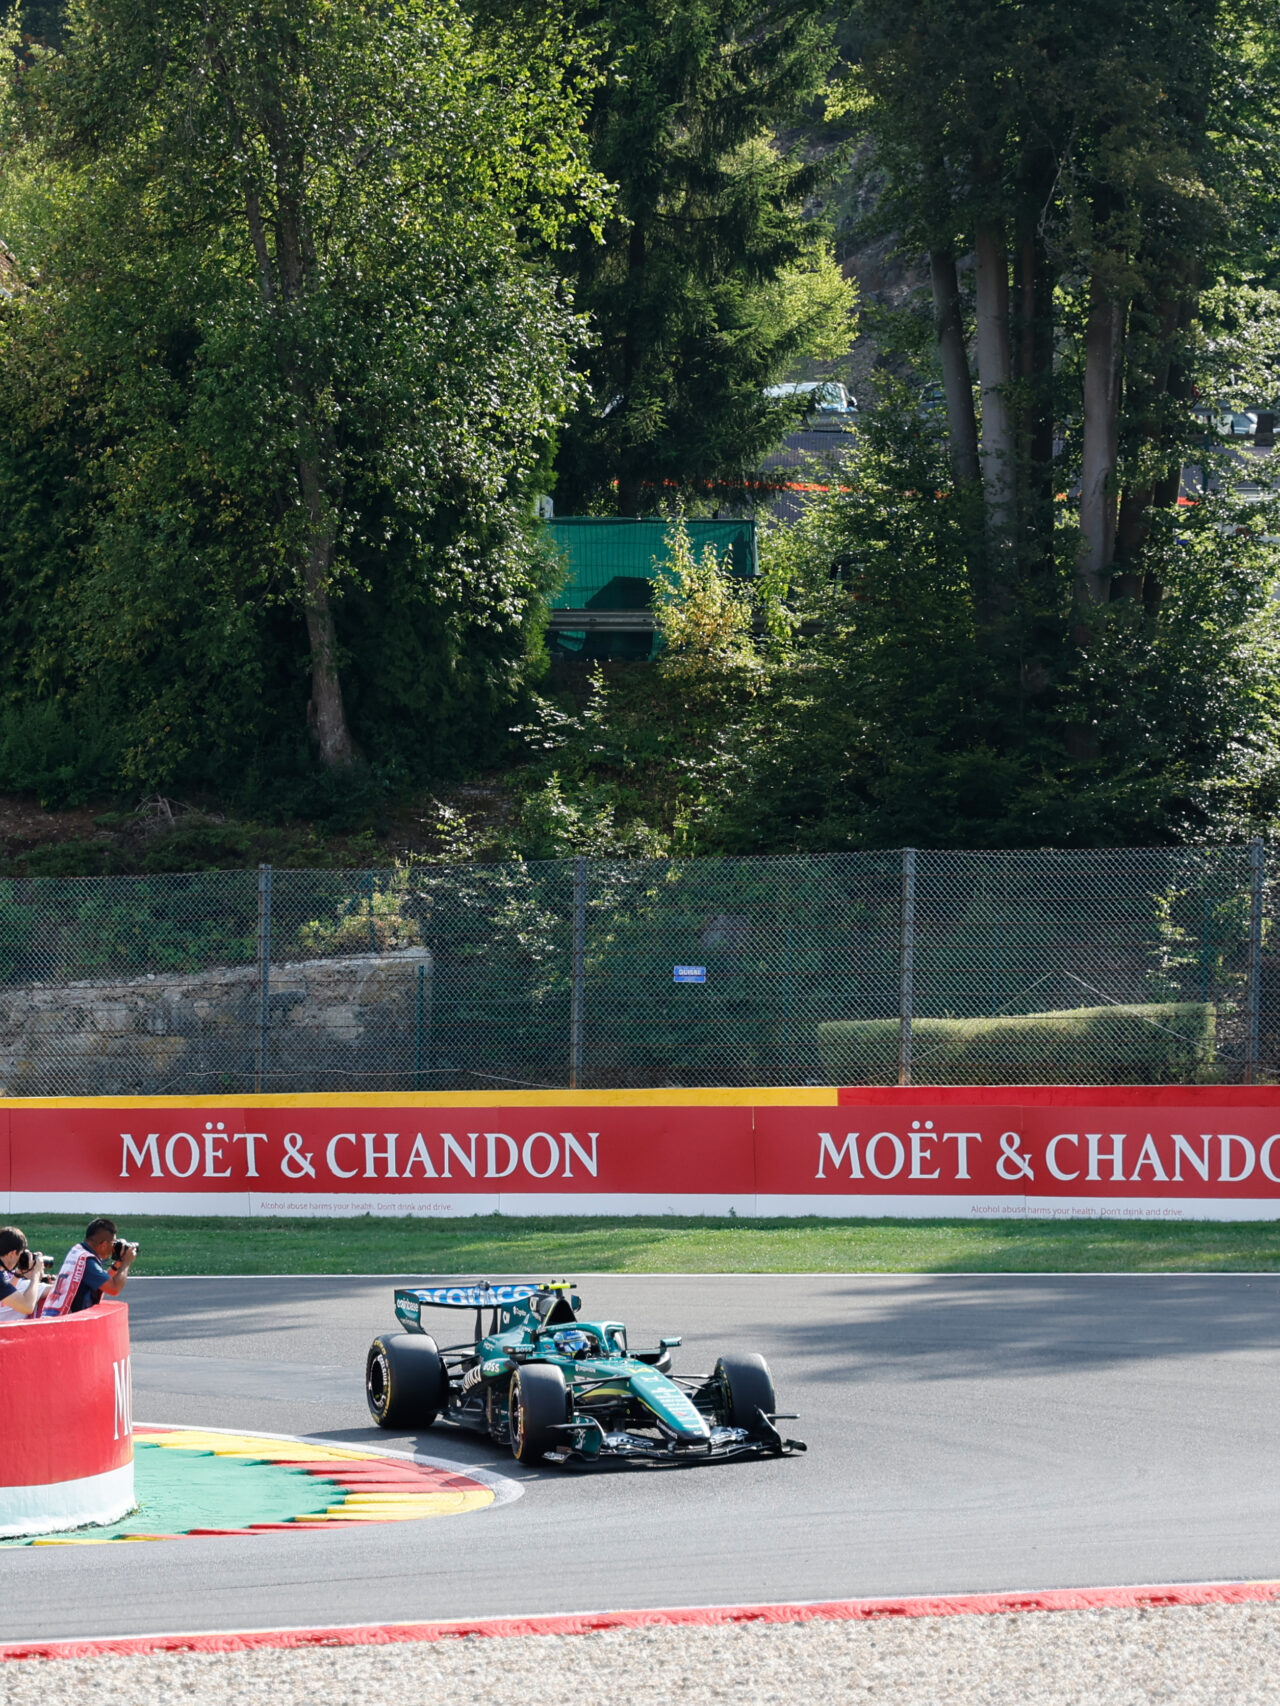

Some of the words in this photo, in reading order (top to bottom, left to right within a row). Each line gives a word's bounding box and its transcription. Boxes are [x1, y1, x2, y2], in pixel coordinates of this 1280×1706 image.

[120, 1122, 268, 1178] MOËT
[281, 1132, 316, 1179] &
[326, 1132, 600, 1179] CHANDON
[815, 1120, 982, 1180] MOËT
[996, 1131, 1035, 1181] &
[261, 1201, 286, 1210] Alcohol
[286, 1202, 308, 1210] abuse
[309, 1202, 332, 1210] harms
[333, 1204, 350, 1213] your
[377, 1203, 396, 1211] Don't
[397, 1202, 416, 1211] drink
[418, 1203, 432, 1211] and
[433, 1203, 452, 1211] drive.
[971, 1204, 1001, 1214] Alcohol
[1001, 1205, 1026, 1214] abuse
[1027, 1205, 1051, 1214] harms
[1052, 1207, 1071, 1217] your
[1100, 1206, 1121, 1215] Don't
[1123, 1206, 1143, 1216] drink
[1145, 1207, 1161, 1216] and
[1163, 1207, 1185, 1217] drive.
